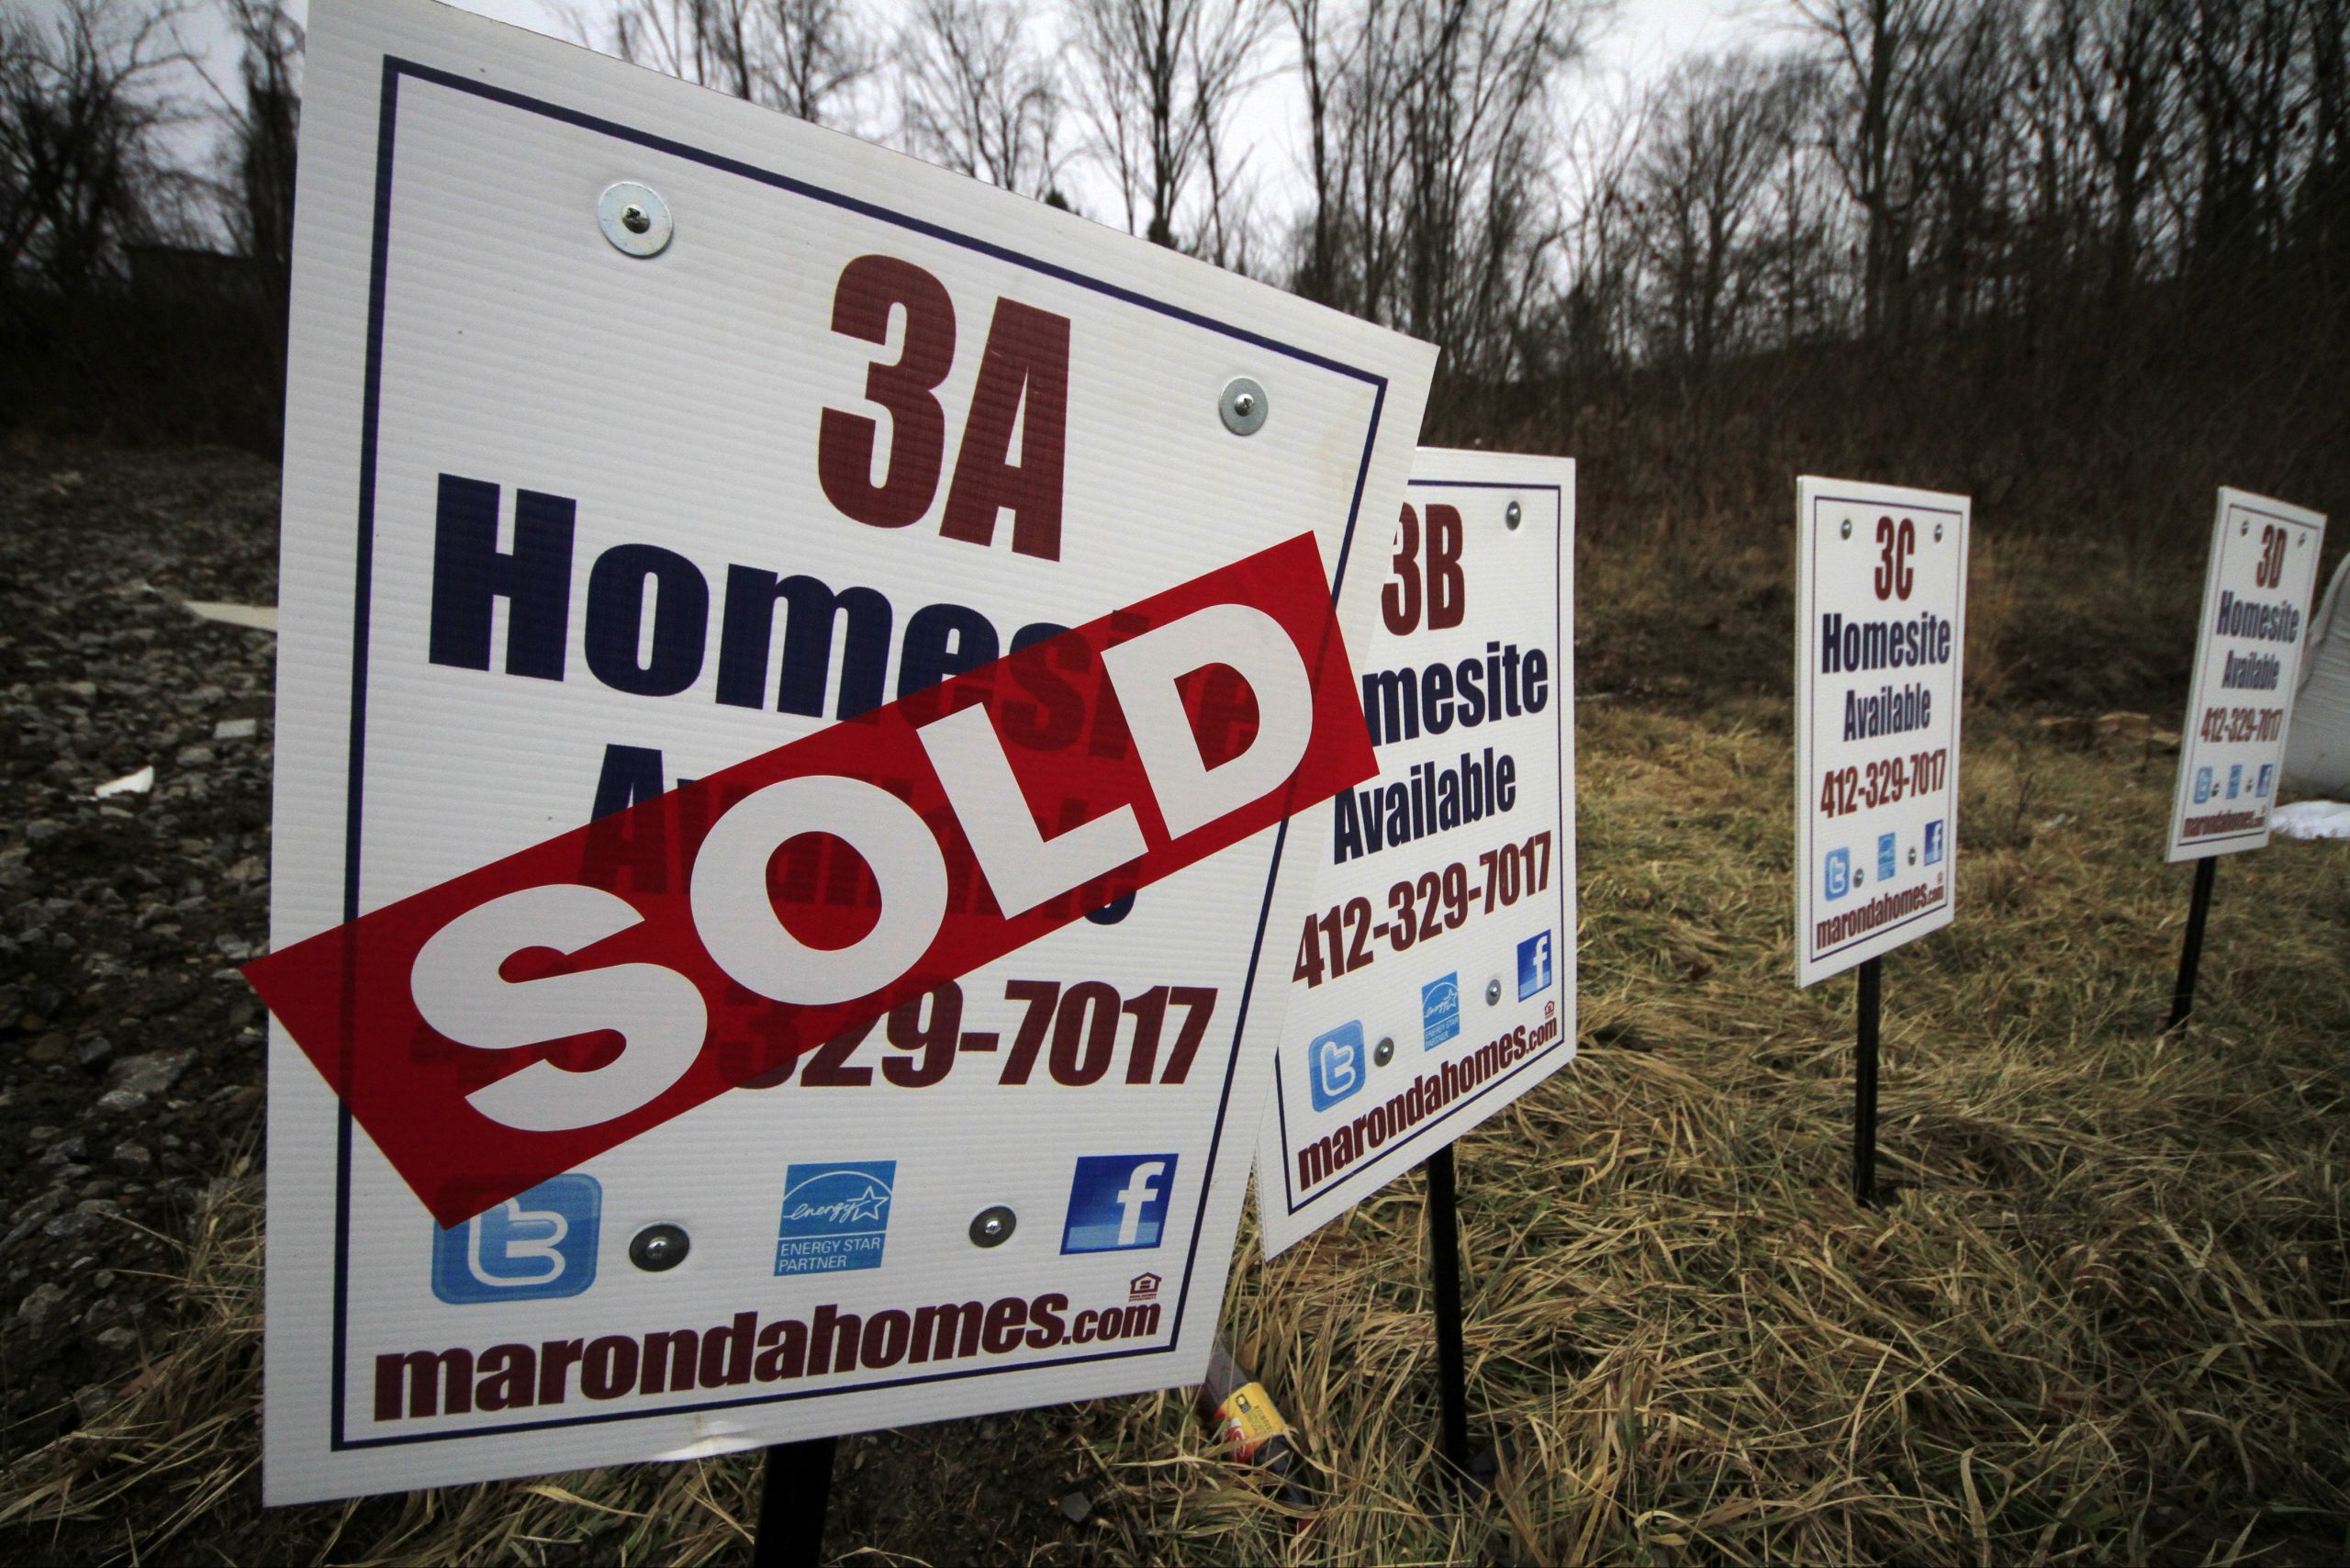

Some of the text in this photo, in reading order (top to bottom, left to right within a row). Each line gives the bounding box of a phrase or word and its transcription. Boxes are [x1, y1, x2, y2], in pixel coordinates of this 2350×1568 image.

[818, 254, 1071, 562] 3A
[1381, 501, 1465, 636] 3B
[1874, 516, 1915, 601] 3C
[2255, 523, 2288, 588] 3D
[1822, 610, 1951, 674] Homesite
[2216, 589, 2300, 644] Homesite
[1361, 641, 1549, 748] mesite
[1843, 682, 1931, 742] Available
[1334, 746, 1516, 865] Available
[1820, 748, 1946, 819] 412-329-7017
[410, 604, 1313, 1131] SOLD
[1292, 830, 1552, 990] 412-329-7017
[1817, 883, 1944, 950] marondahomes.com
[1297, 1017, 1558, 1192] marondahomes.com
[778, 1255, 846, 1272] PARTNER
[781, 1237, 880, 1257] ENERGY STAR
[374, 1292, 1162, 1422] marondahomes.com
